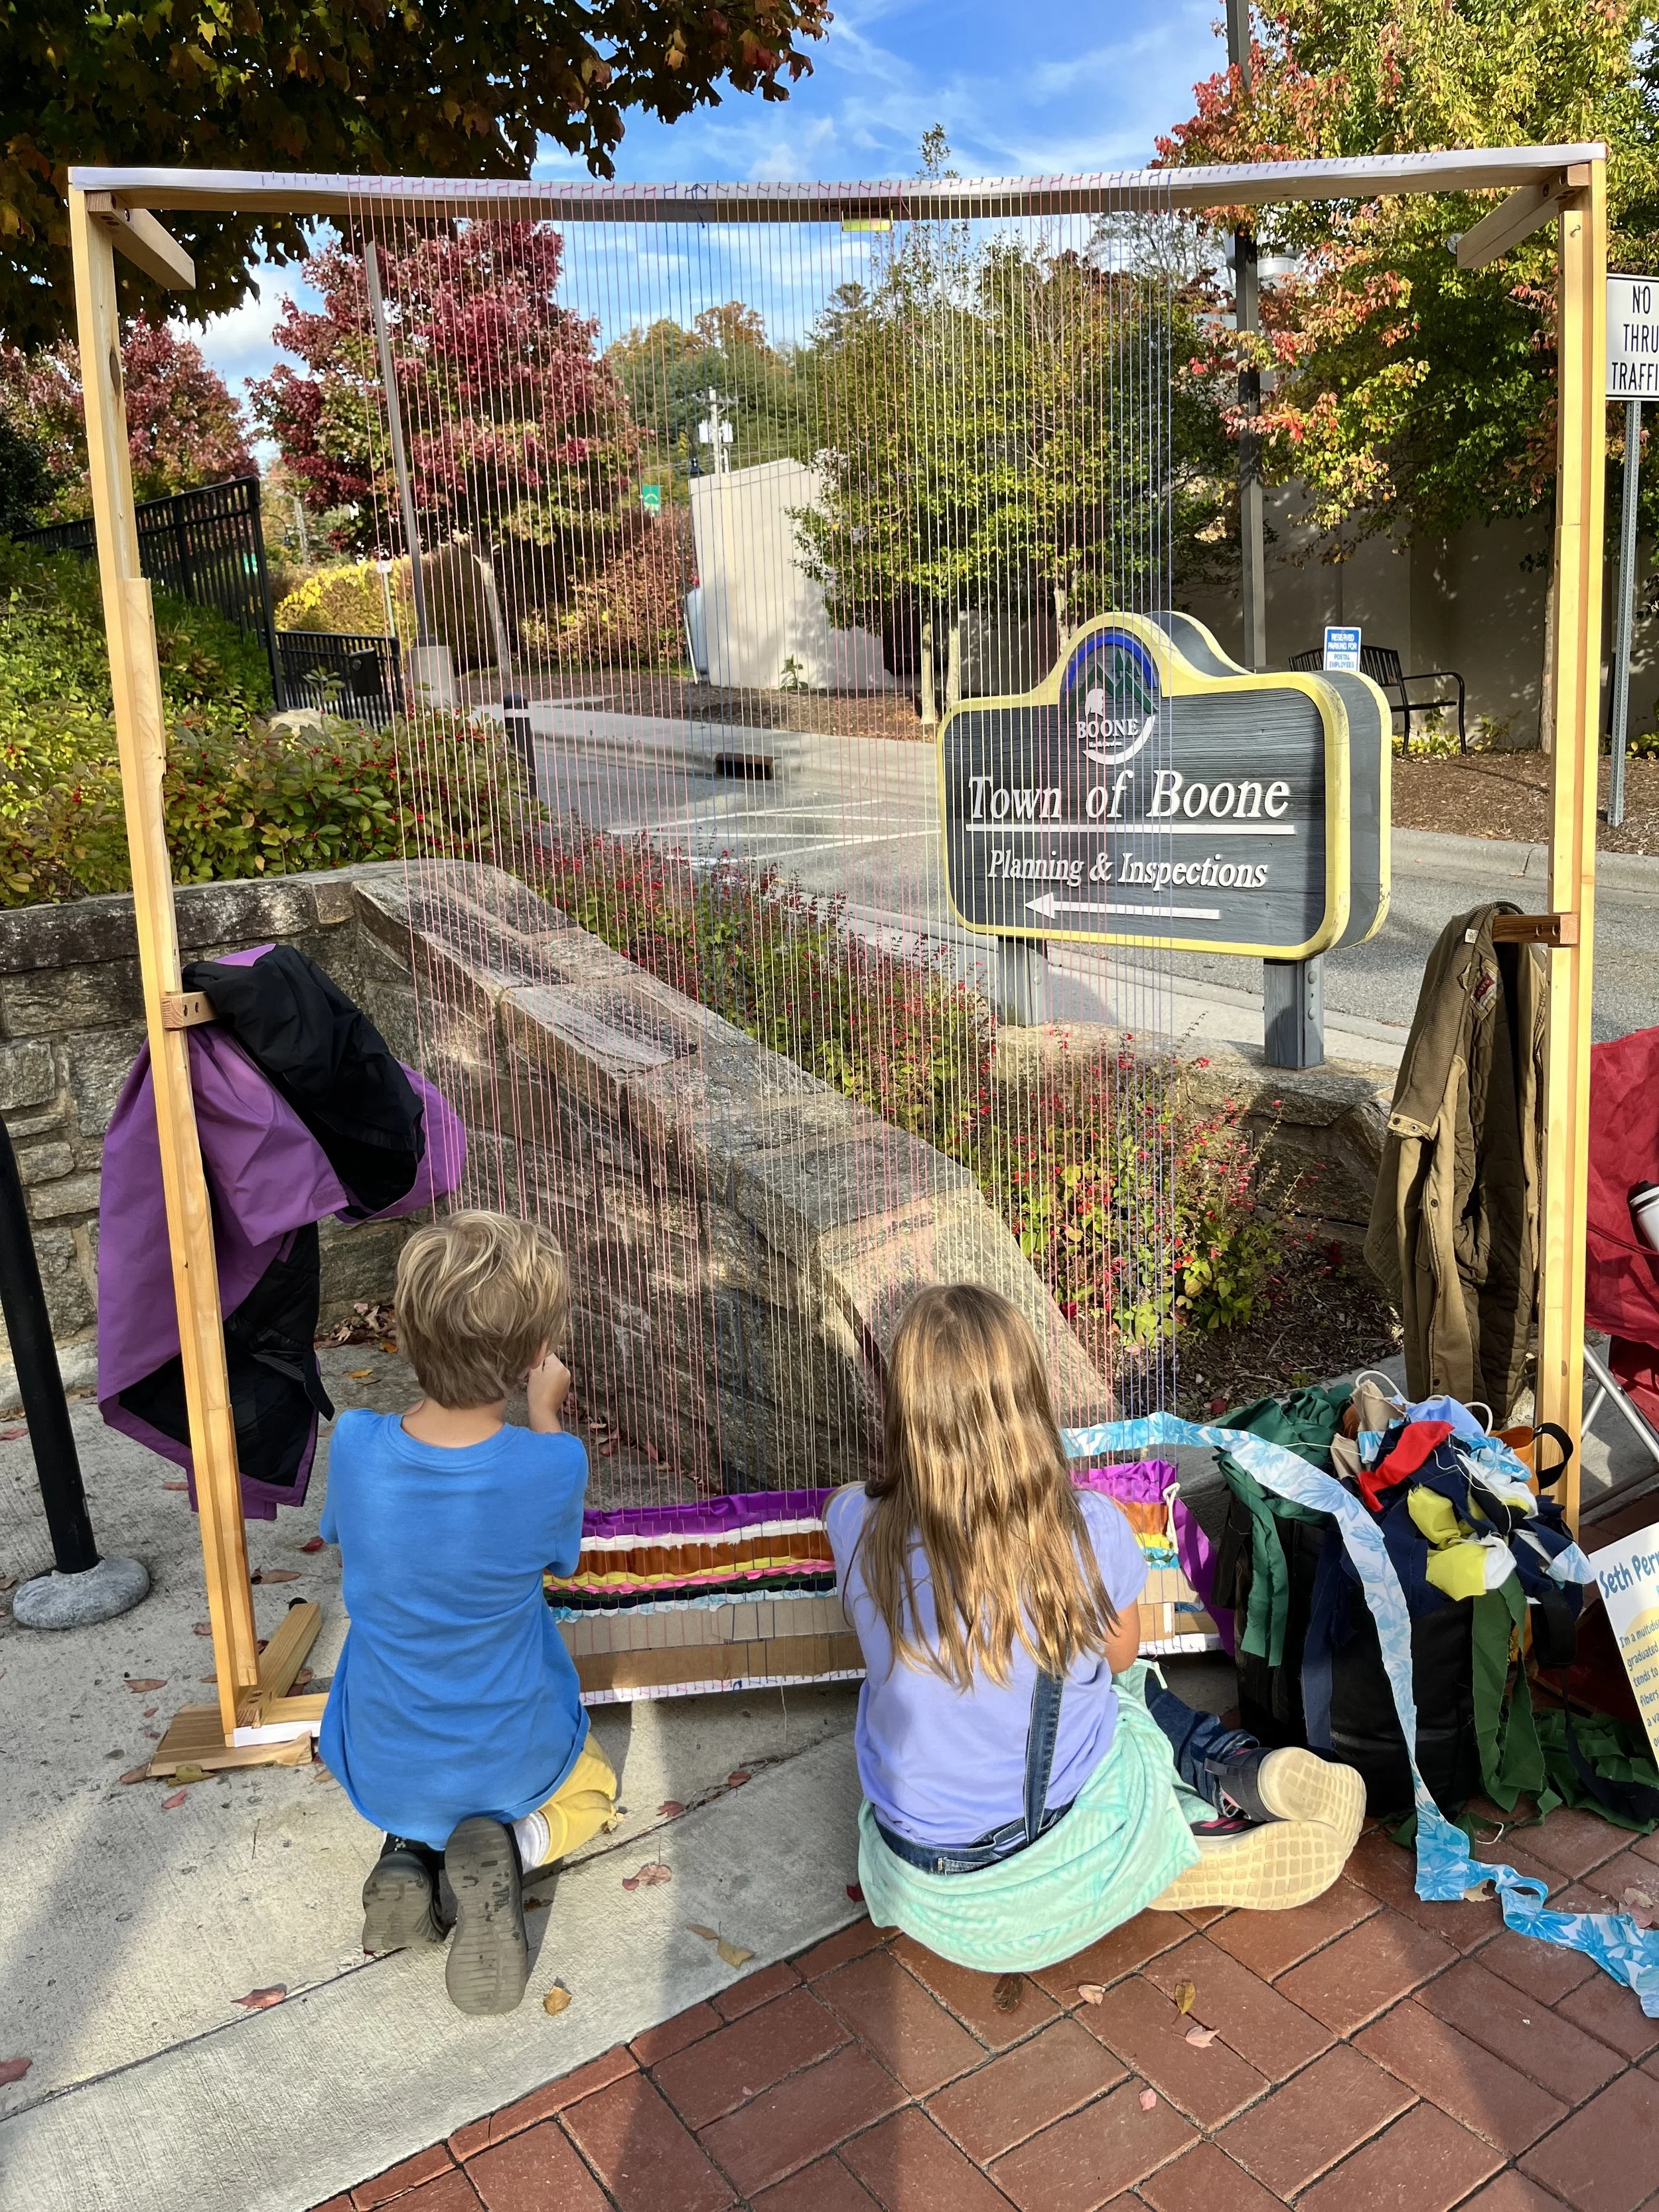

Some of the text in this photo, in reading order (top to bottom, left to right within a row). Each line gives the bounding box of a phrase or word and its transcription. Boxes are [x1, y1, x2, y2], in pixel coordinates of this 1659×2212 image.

[1632, 285, 1651, 314] NO
[1623, 323, 1659, 353] THRU
[1331, 633, 1355, 642] RESERVED
[1347, 642, 1357, 650] FOR
[1076, 718, 1139, 739] BOONE
[968, 769, 1290, 819] Town of Boone
[987, 849, 1268, 891] Planning & Inspections
[1599, 1562, 1634, 1599] Seth
[1630, 1633, 1636, 1642] a
[1636, 1619, 1659, 1640] multidis
[1627, 1641, 1658, 1671] graduated
[1633, 1666, 1658, 1687] tends to
[1646, 1718, 1652, 1727] a
